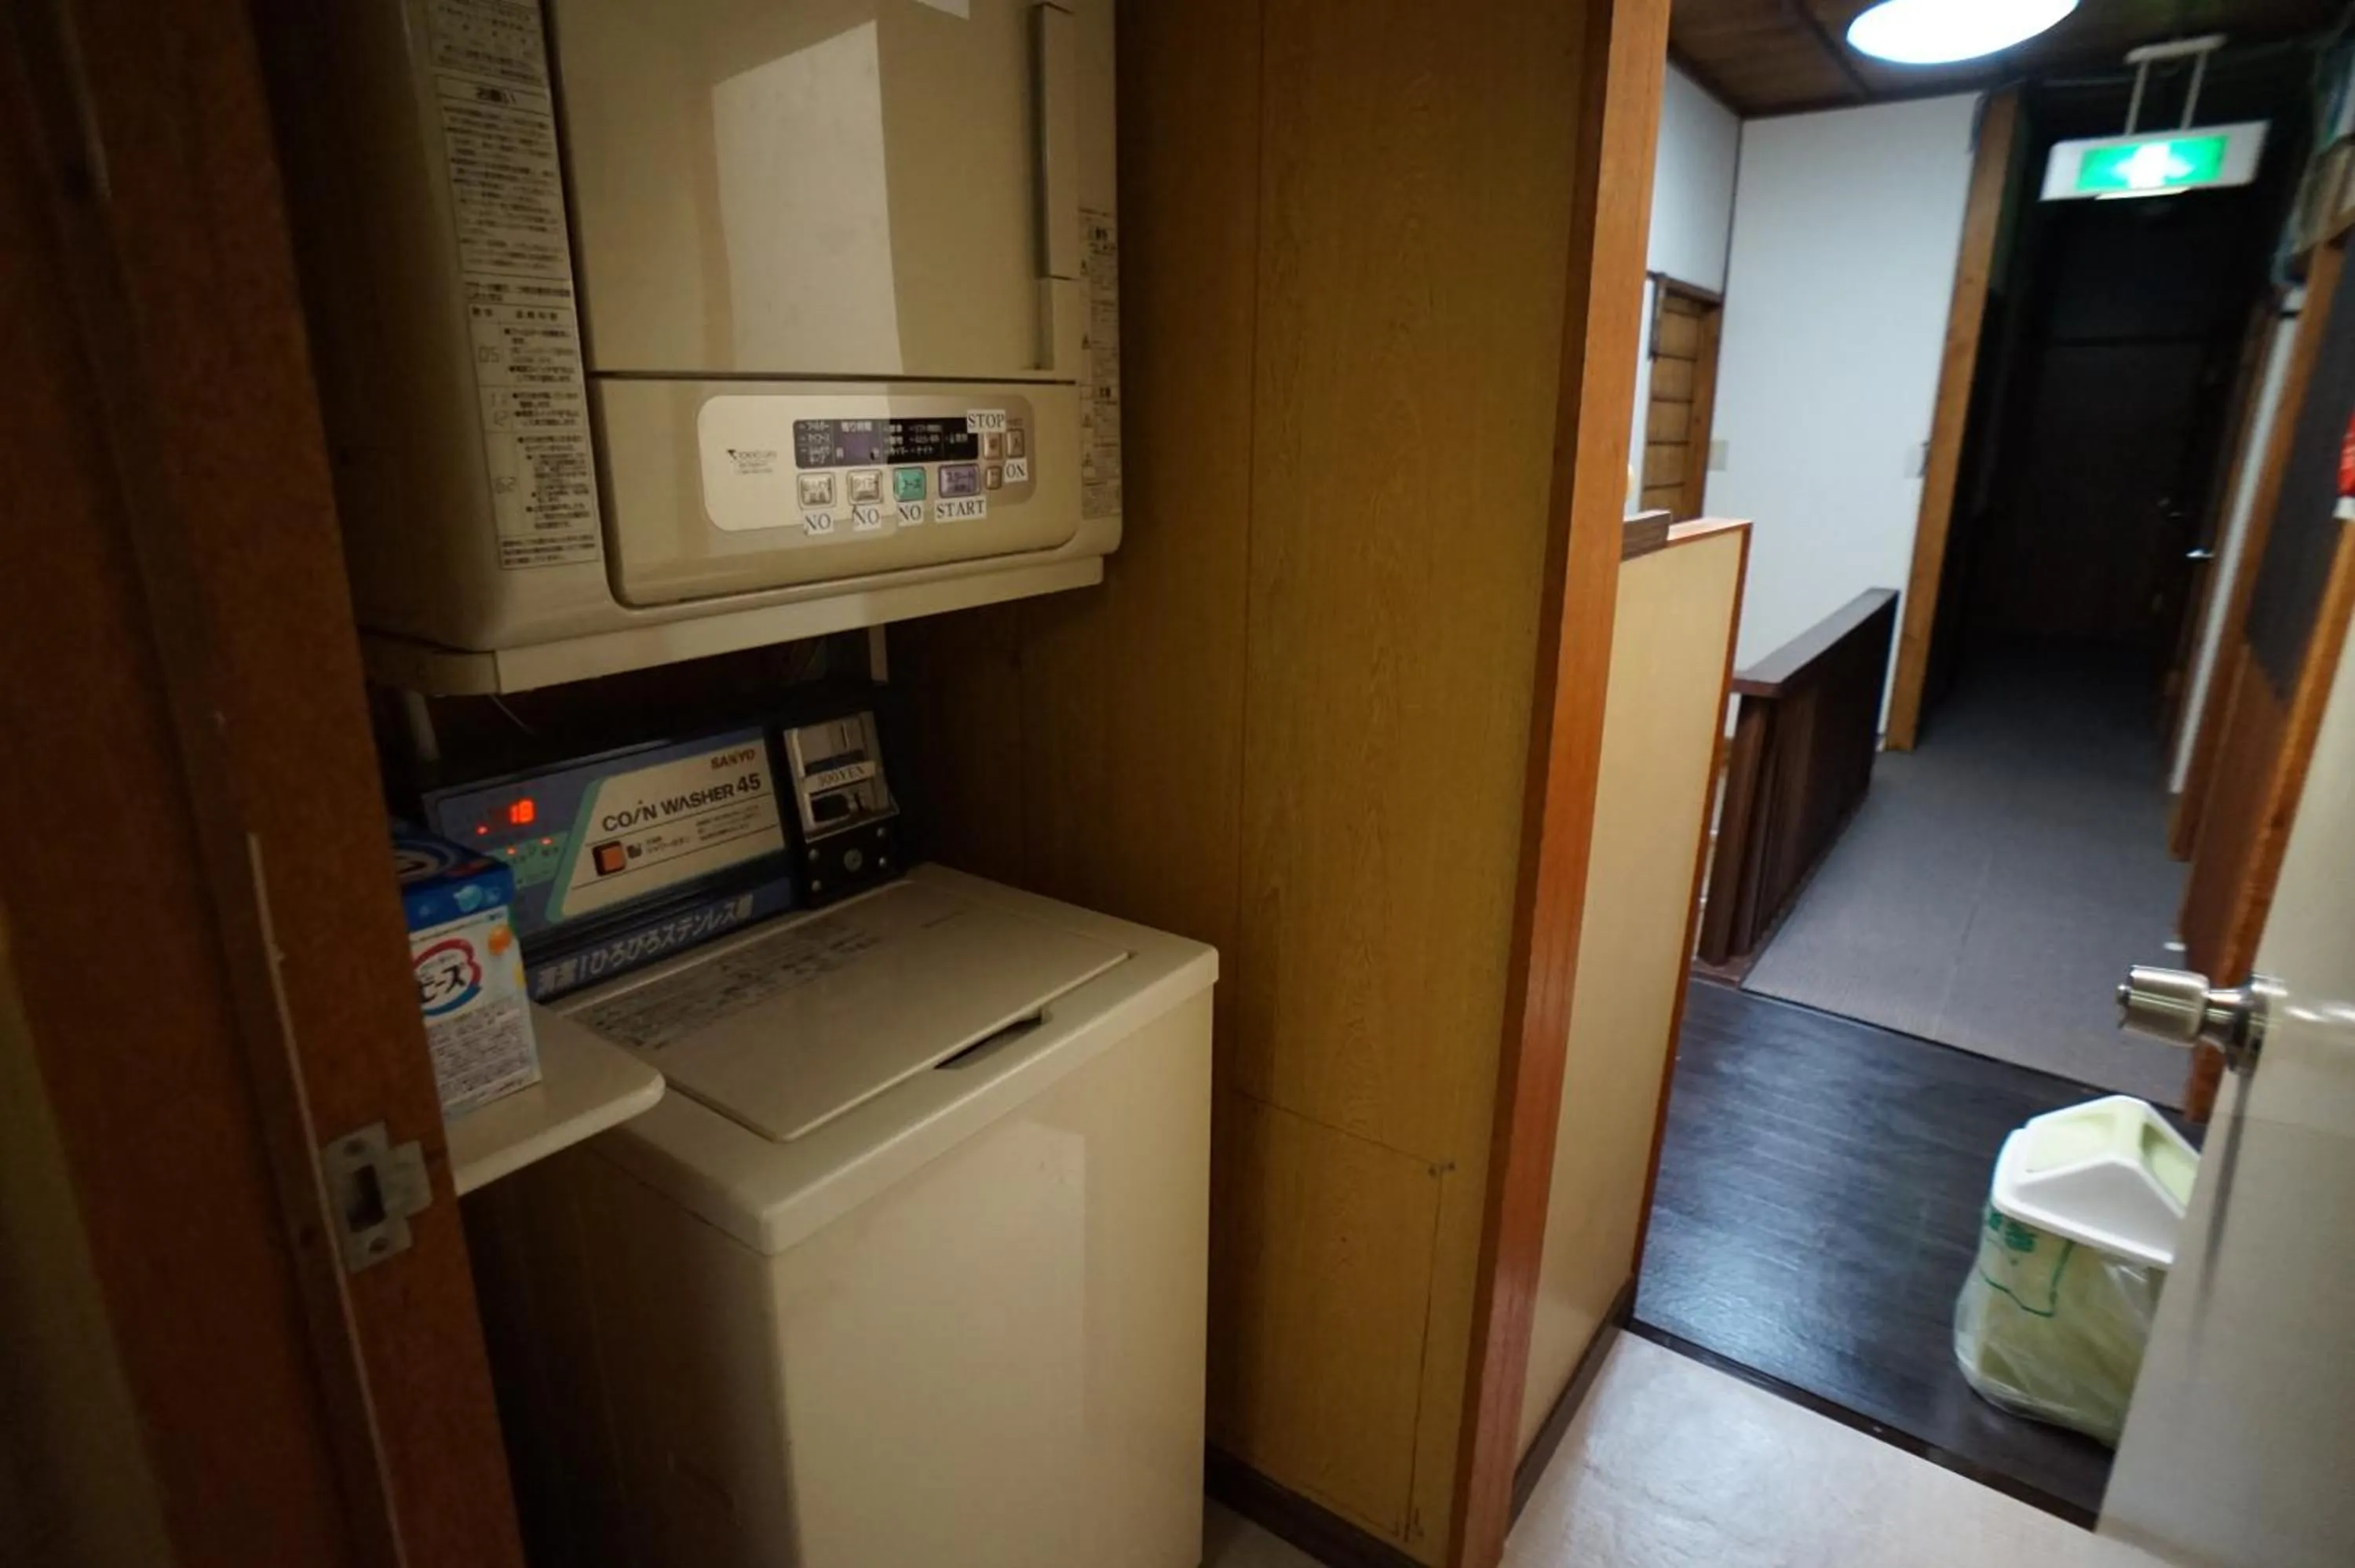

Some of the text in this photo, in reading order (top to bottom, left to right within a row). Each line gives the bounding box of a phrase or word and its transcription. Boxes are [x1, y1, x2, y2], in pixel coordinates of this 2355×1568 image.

[968, 414, 1005, 429] STOP
[1006, 461, 1025, 479] ON
[853, 508, 880, 525] NO
[898, 504, 922, 520] NO
[936, 499, 985, 519] START
[805, 516, 831, 532] NO
[710, 748, 756, 771] SANYO
[662, 785, 734, 816] WASHER
[736, 773, 761, 795] 45
